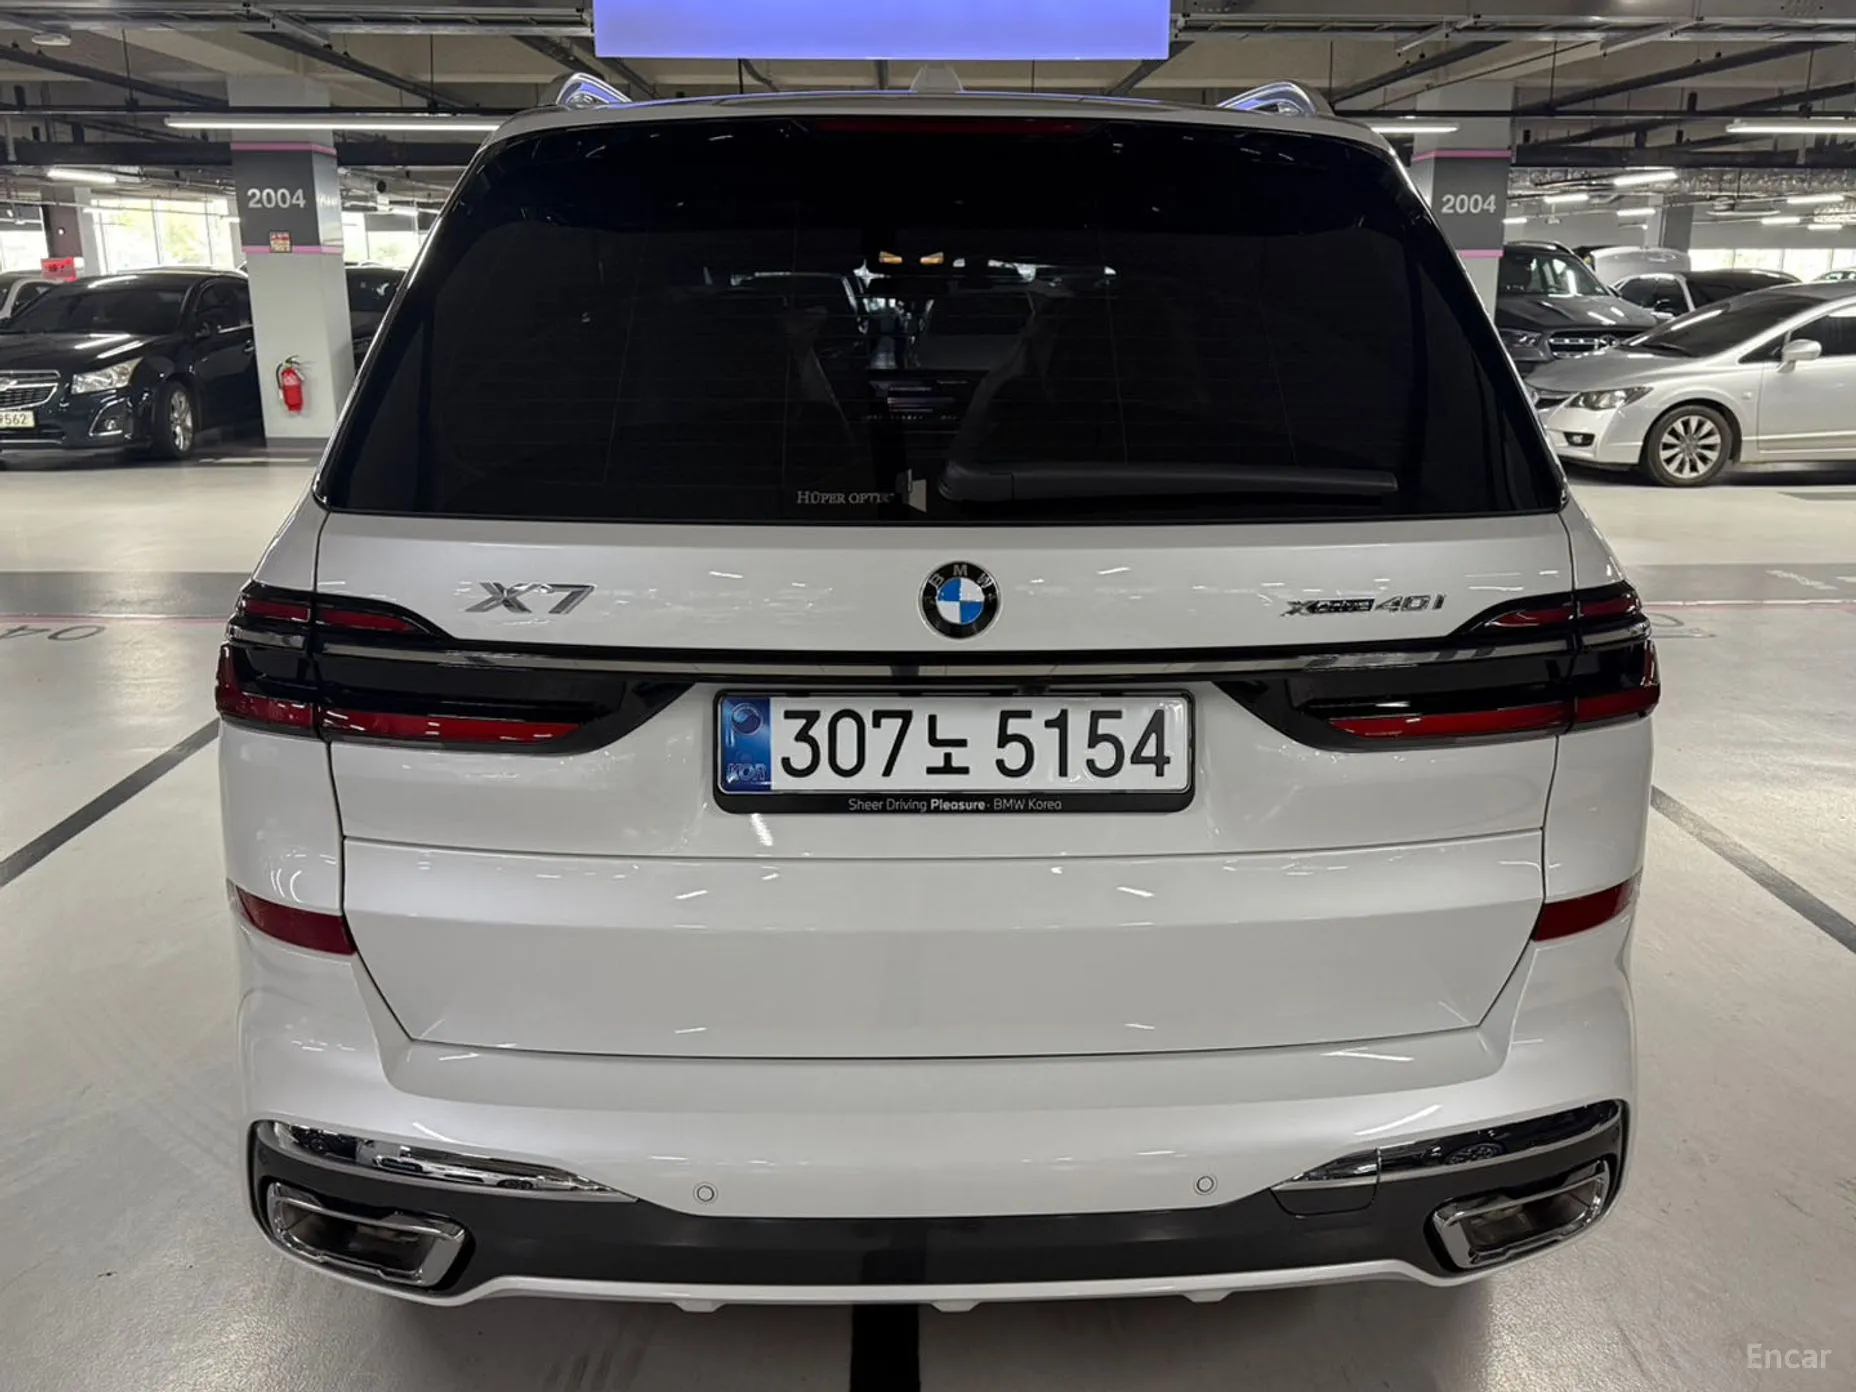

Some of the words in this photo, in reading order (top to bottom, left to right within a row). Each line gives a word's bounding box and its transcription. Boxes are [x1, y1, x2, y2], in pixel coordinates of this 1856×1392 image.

[247, 187, 306, 208] 2004
[1441, 194, 1496, 213] 2004
[928, 564, 994, 588] BMW
[464, 581, 596, 614] X7
[781, 708, 969, 778] 307노
[995, 708, 1171, 778] 5154
[727, 762, 767, 784] KOR
[848, 799, 883, 811] Sheer
[886, 799, 927, 812] Driving
[930, 798, 985, 811] Pleasure
[994, 798, 1025, 810] BMW
[1028, 798, 1062, 810] Korea
